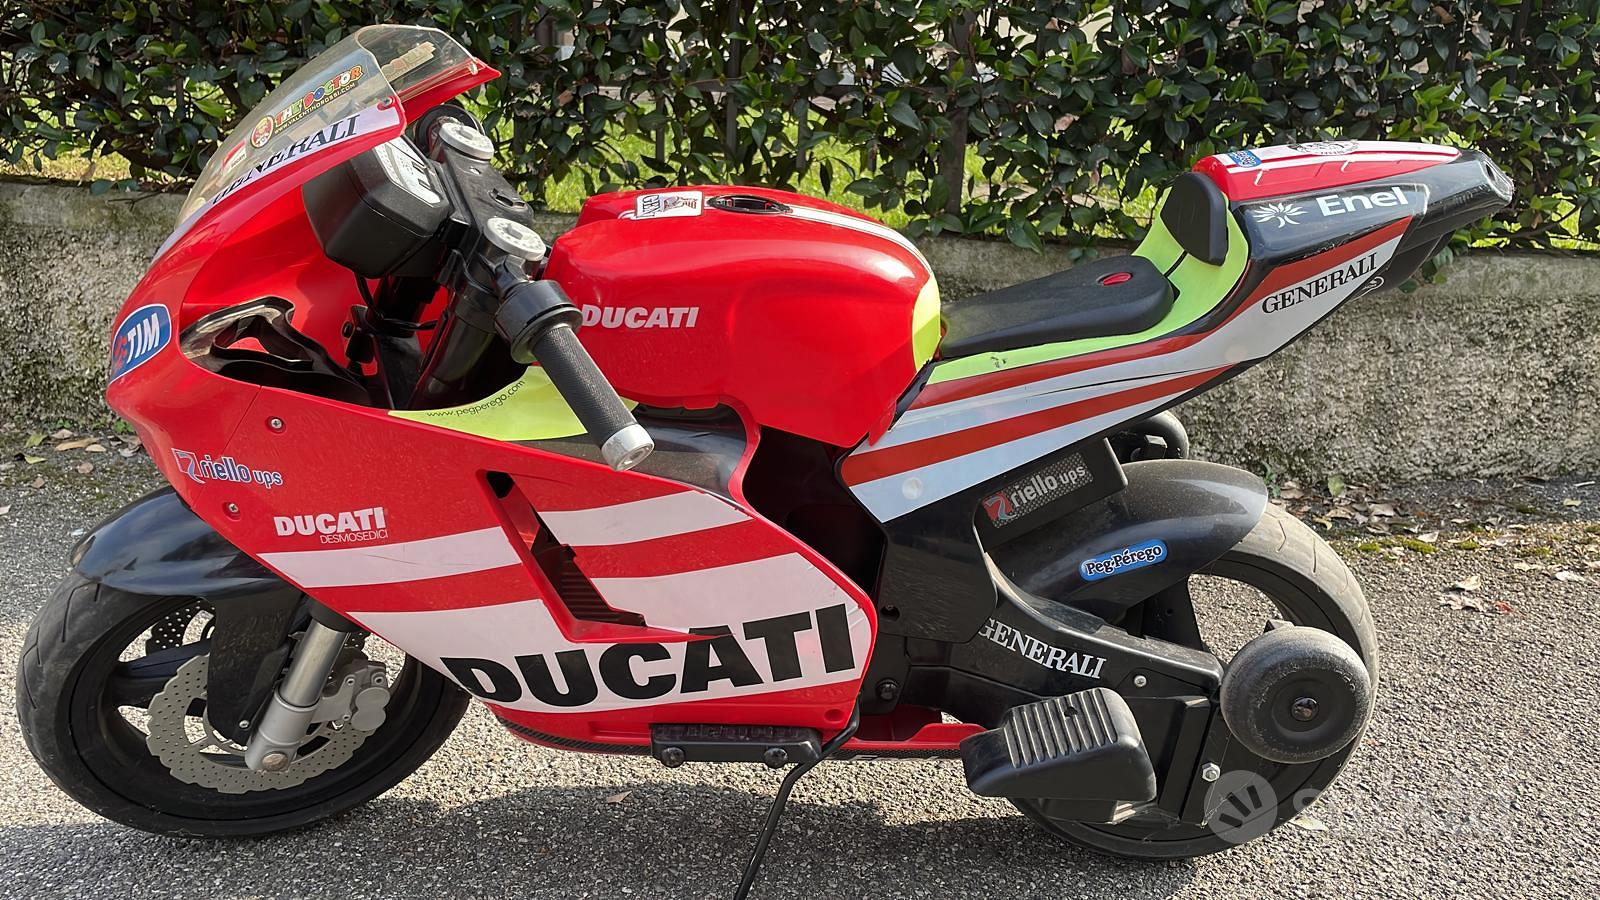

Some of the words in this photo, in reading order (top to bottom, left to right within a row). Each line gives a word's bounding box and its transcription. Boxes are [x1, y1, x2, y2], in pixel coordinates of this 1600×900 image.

[274, 98, 302, 128] THE
[303, 64, 364, 109] DOCTOR
[1316, 186, 1409, 217] Enel
[1261, 252, 1378, 314] GENERALI
[581, 304, 700, 329] DUCATI
[126, 312, 160, 364] TIM
[427, 380, 525, 417] www.pegperego.com
[200, 455, 251, 483] riello
[252, 470, 283, 489] ups
[1010, 473, 1058, 508] riello
[1060, 465, 1086, 486] ups
[273, 506, 386, 537] DUCATI
[320, 529, 389, 544] DESMOSEDICI
[440, 602, 856, 708] DUCATI
